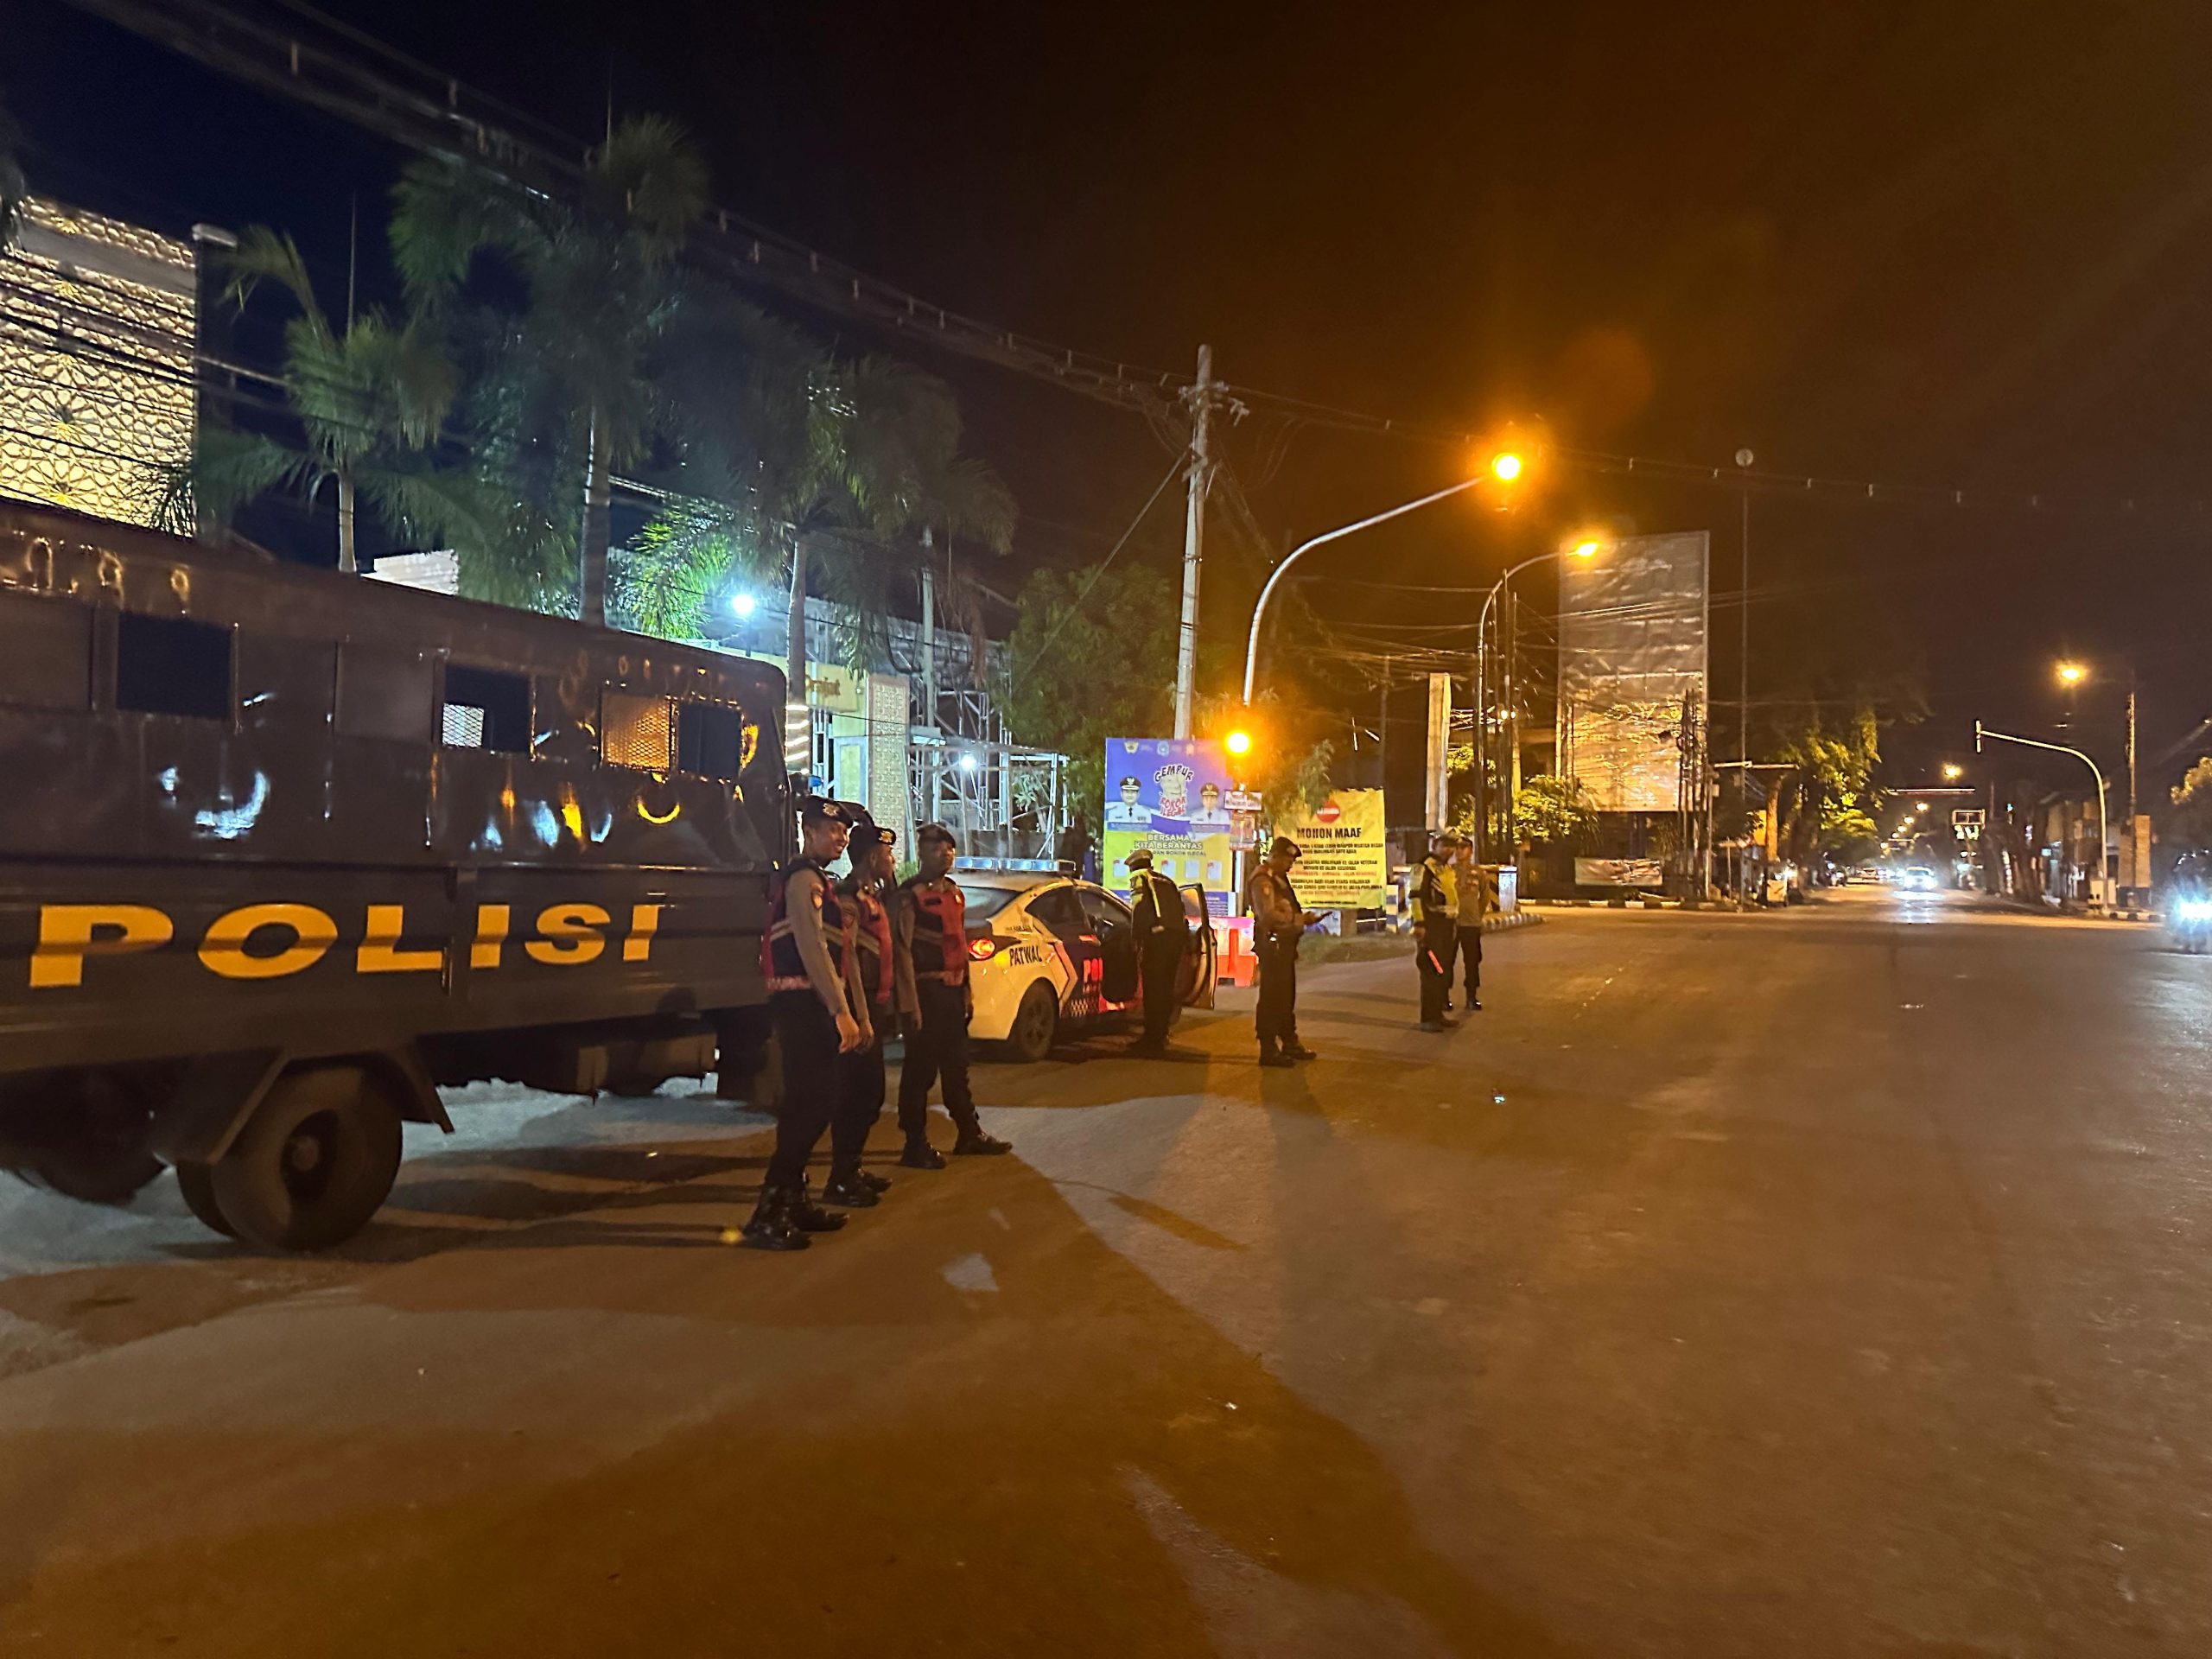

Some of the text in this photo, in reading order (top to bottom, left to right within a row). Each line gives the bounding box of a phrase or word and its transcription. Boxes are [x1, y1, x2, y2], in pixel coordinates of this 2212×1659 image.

[1154, 764, 1193, 782] GEMPUR
[1160, 796, 1186, 808] ROKOK
[1160, 807, 1185, 817] ILEGAL
[1296, 827, 1362, 839] MOHON MAAF
[1135, 841, 1203, 850] KITA BERANTAS
[29, 903, 659, 988] POLISI
[1009, 945, 1042, 967] PATWAL
